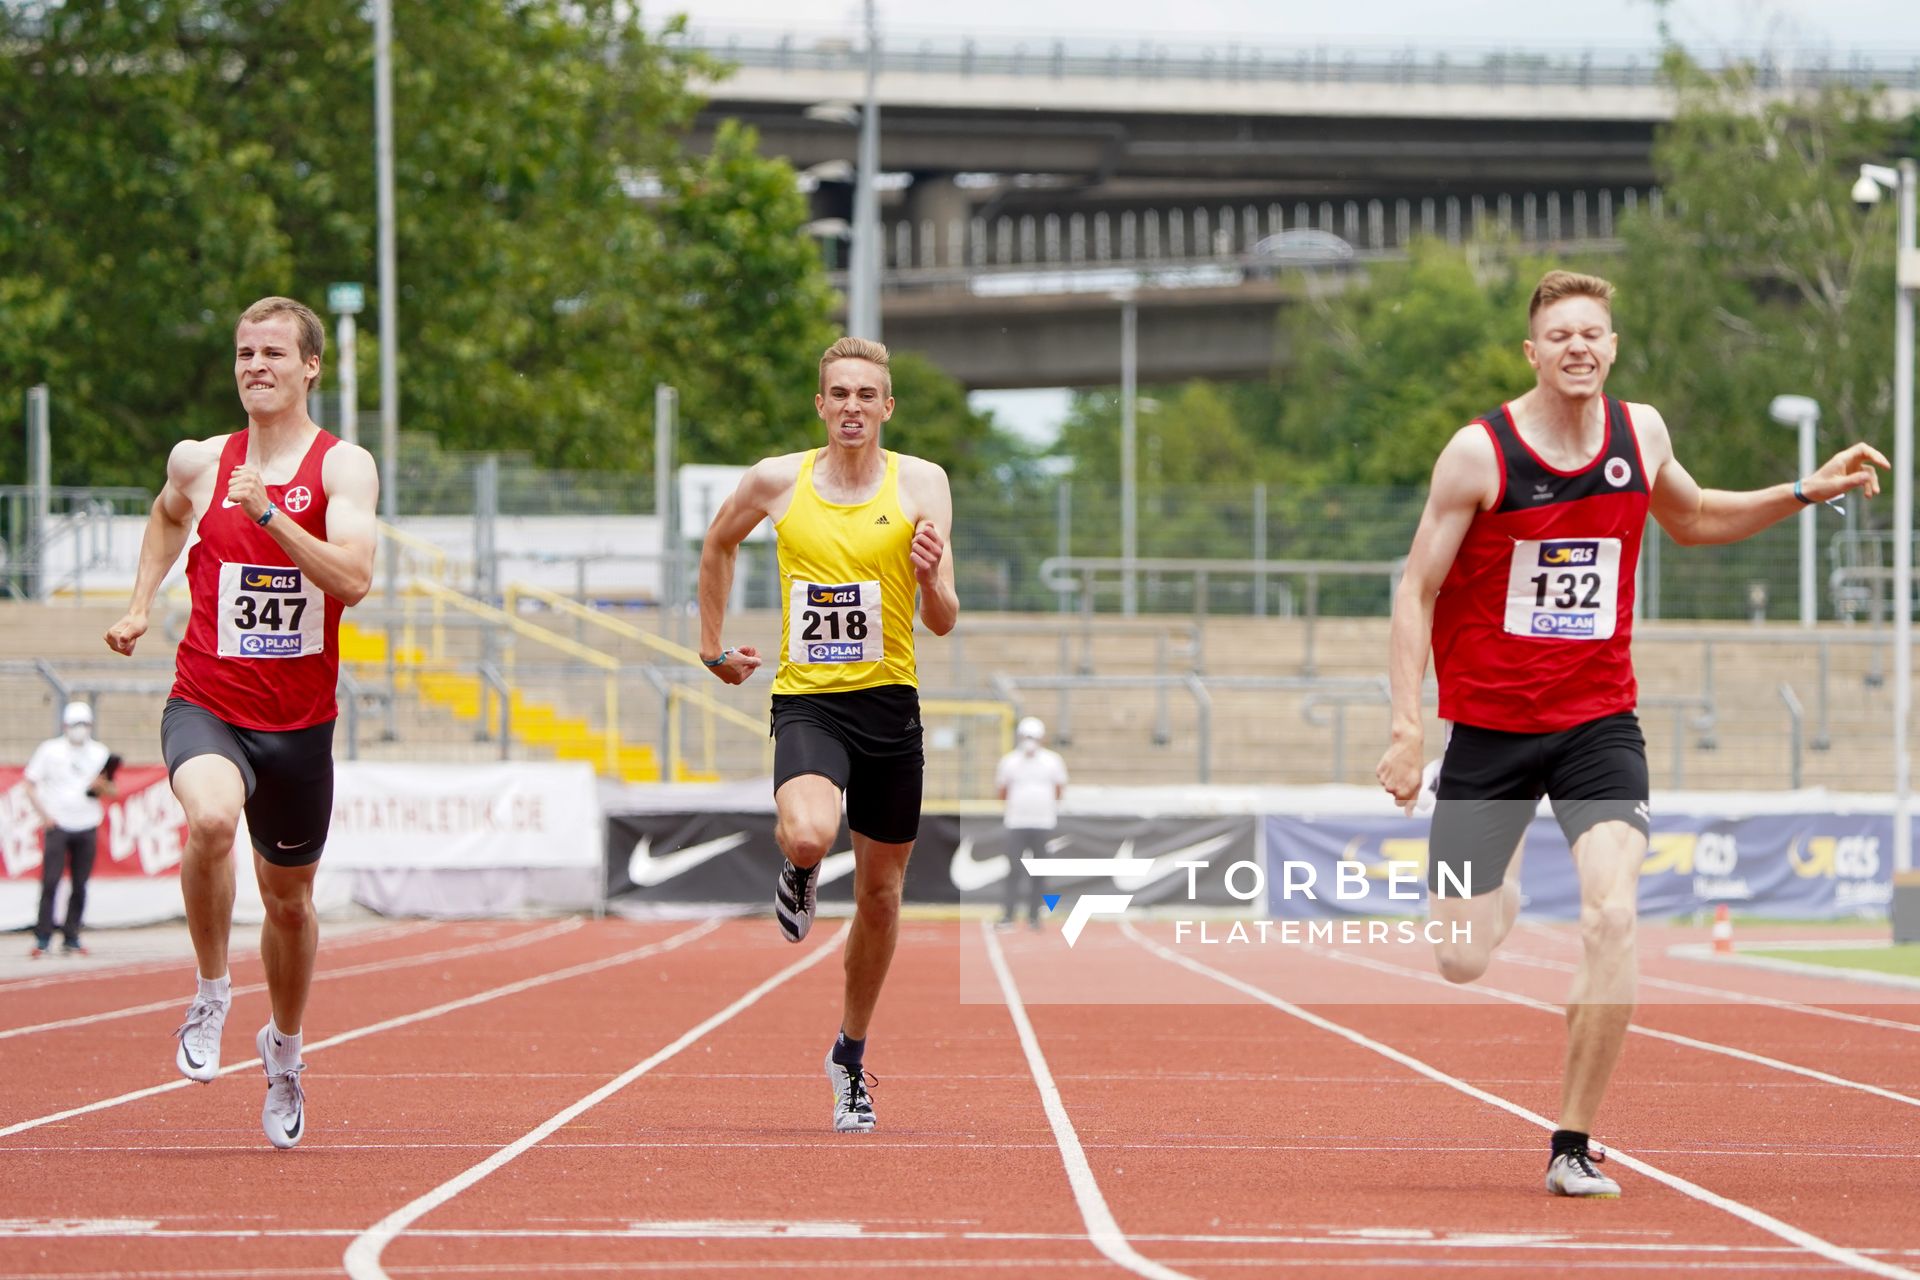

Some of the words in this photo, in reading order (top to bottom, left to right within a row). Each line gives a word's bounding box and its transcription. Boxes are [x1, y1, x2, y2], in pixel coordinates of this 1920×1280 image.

[1571, 548, 1594, 562] GLS
[271, 576, 296, 588] GLS
[1531, 573, 1601, 608] 132
[834, 591, 855, 603] GLS
[234, 596, 307, 630] 347
[802, 611, 867, 640] 218
[1558, 616, 1593, 628] PLAN
[265, 638, 299, 649] PLAN
[830, 646, 860, 655] PLAN
